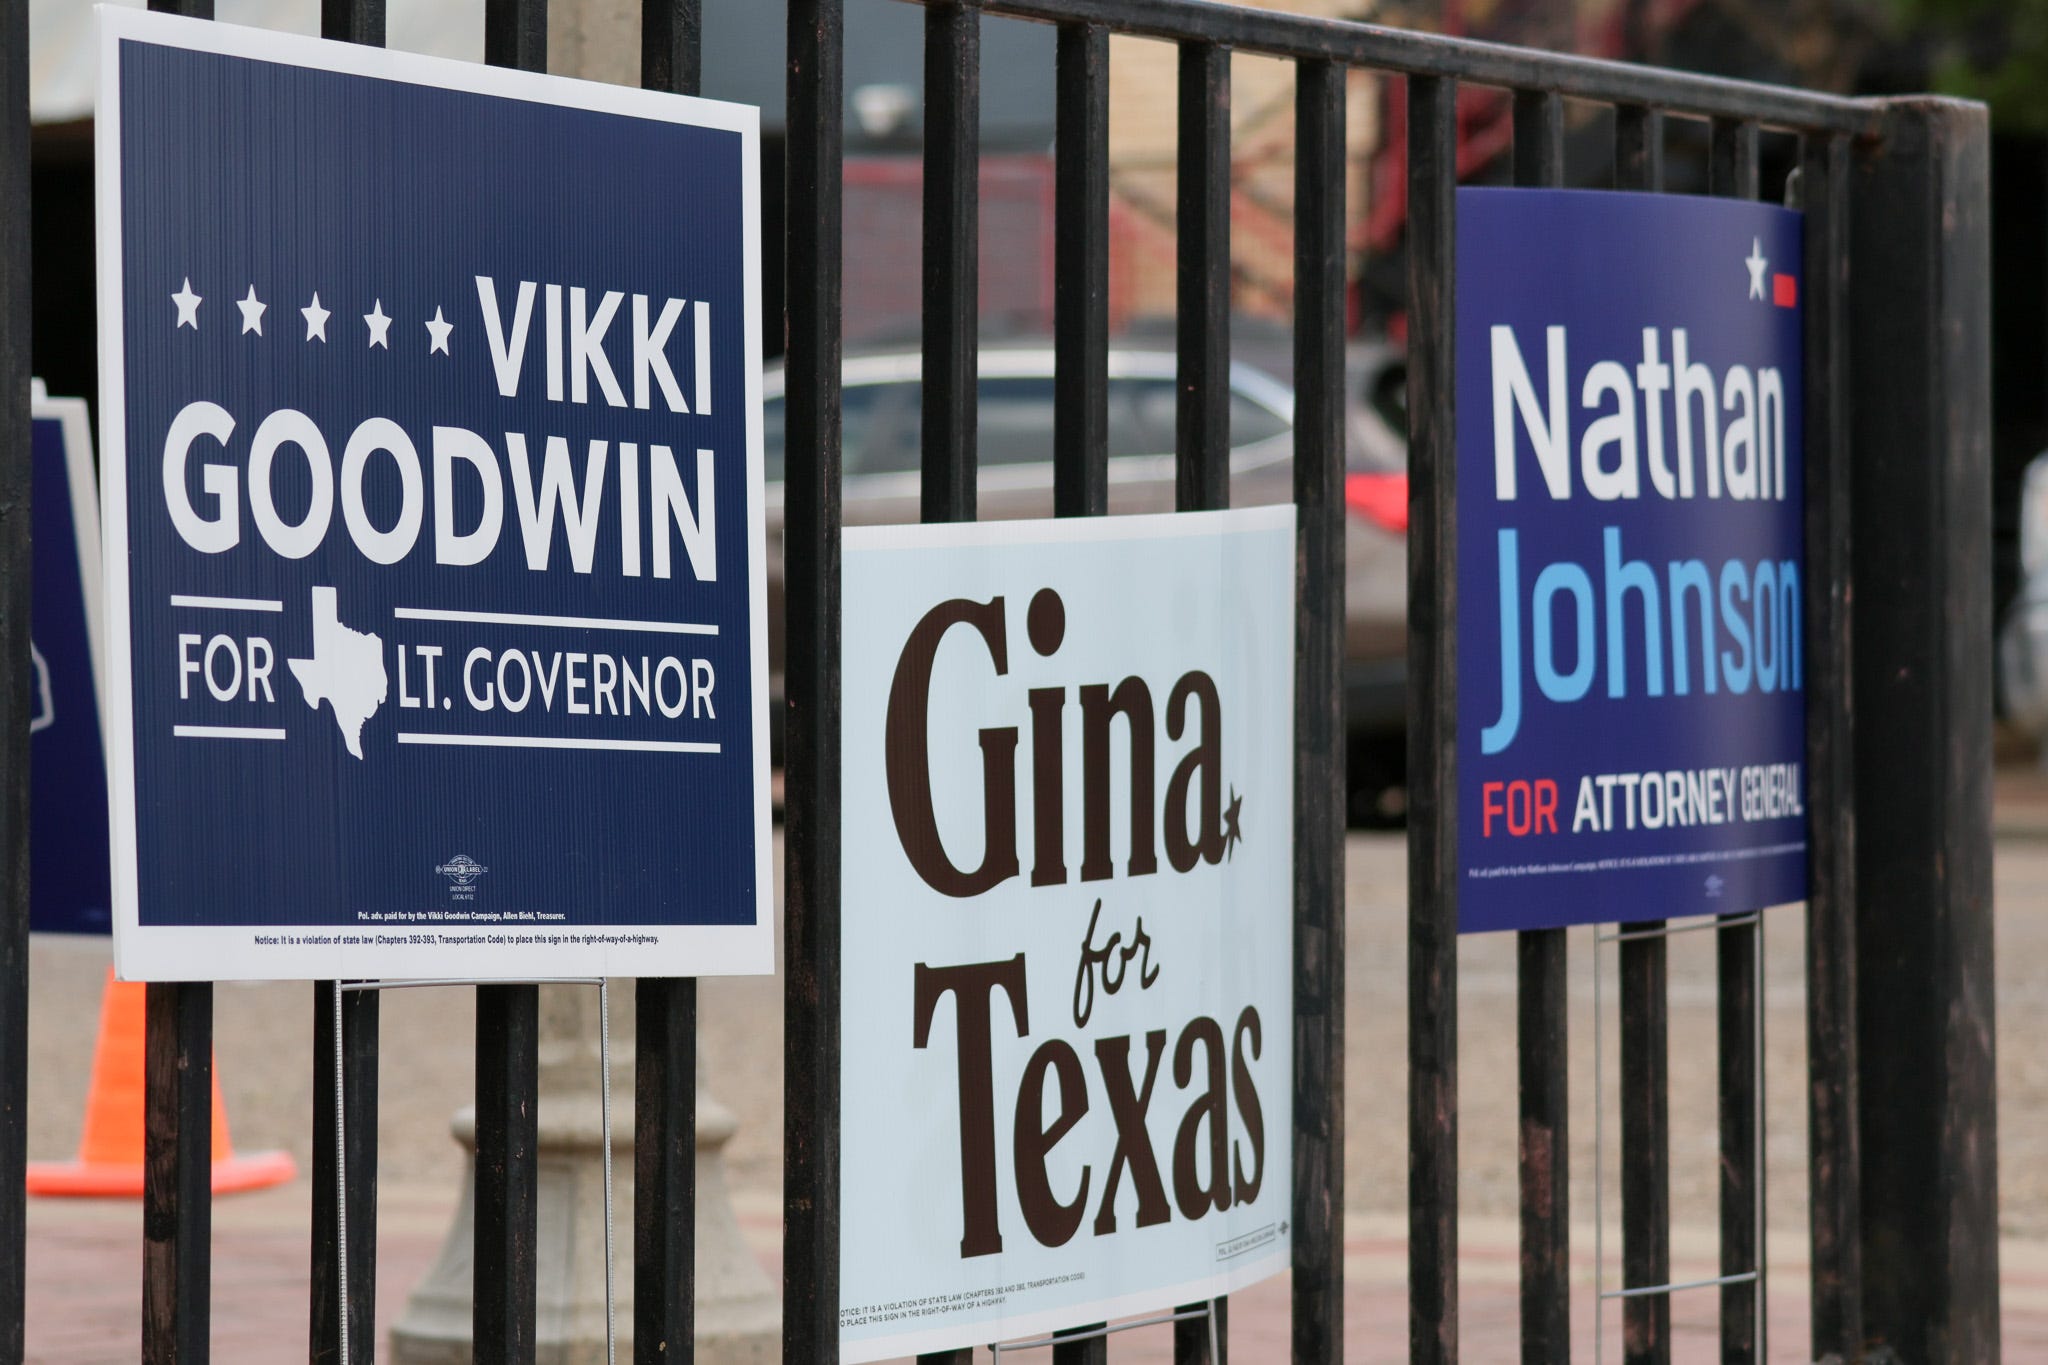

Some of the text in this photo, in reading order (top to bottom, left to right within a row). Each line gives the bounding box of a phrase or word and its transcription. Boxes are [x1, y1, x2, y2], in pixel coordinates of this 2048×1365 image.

[475, 276, 712, 416] VIKKI
[1490, 325, 1786, 501] Nathan
[163, 401, 717, 582] GOODWIN
[178, 633, 716, 719] FOR LT. GOVERNOR
[1481, 526, 1801, 755] Johnson
[885, 587, 1228, 898] Gina
[1482, 763, 1803, 837] FOR ATTORNEY GENERAL
[254, 935, 279, 945] Notice:
[281, 935, 287, 945] It
[288, 935, 294, 945] is
[296, 937, 300, 945] a
[302, 935, 332, 945] violation
[333, 935, 341, 945] of
[343, 935, 360, 945] state
[361, 935, 373, 944] law
[375, 934, 407, 946] (Chapters
[409, 934, 437, 946] 392-393,
[438, 934, 486, 946] Transportation
[487, 934, 506, 946] Code)
[507, 935, 514, 944] to
[515, 934, 533, 946] place
[534, 934, 546, 944] this
[548, 934, 561, 946] sign
[562, 934, 568, 944] in
[570, 934, 580, 944] the
[358, 911, 370, 920] Pol.
[384, 911, 397, 922] paid
[398, 911, 407, 920] for
[408, 911, 415, 922] by
[416, 911, 426, 920] the
[427, 911, 443, 920] Vikki
[444, 911, 470, 920] Goodwin
[471, 911, 502, 922] Campaign,
[503, 911, 518, 920] Allen
[536, 911, 566, 920] Treasurer.
[1073, 897, 1160, 1029] for
[913, 952, 1265, 1259] Texas
[839, 1319, 846, 1328] O
[846, 1316, 867, 1327] PLACE
[868, 1314, 883, 1324] THIS
[884, 1312, 899, 1321] SIGN
[900, 1311, 907, 1319] IN
[908, 1309, 920, 1318] THE
[921, 1301, 965, 1316] RIGHT-OF-WAY
[967, 1300, 975, 1309] OF
[976, 1299, 980, 1307] A
[840, 1307, 861, 1318] OTICE:
[862, 1306, 868, 1314] IT
[869, 1305, 876, 1313] IS
[883, 1300, 918, 1311] VIOLATION
[918, 1298, 927, 1306] OF
[928, 1295, 947, 1305] STATE
[948, 1293, 962, 1303] LAW
[1004, 1284, 1015, 1293] AND
[1027, 1275, 1070, 1289] TRANSPORTATION
